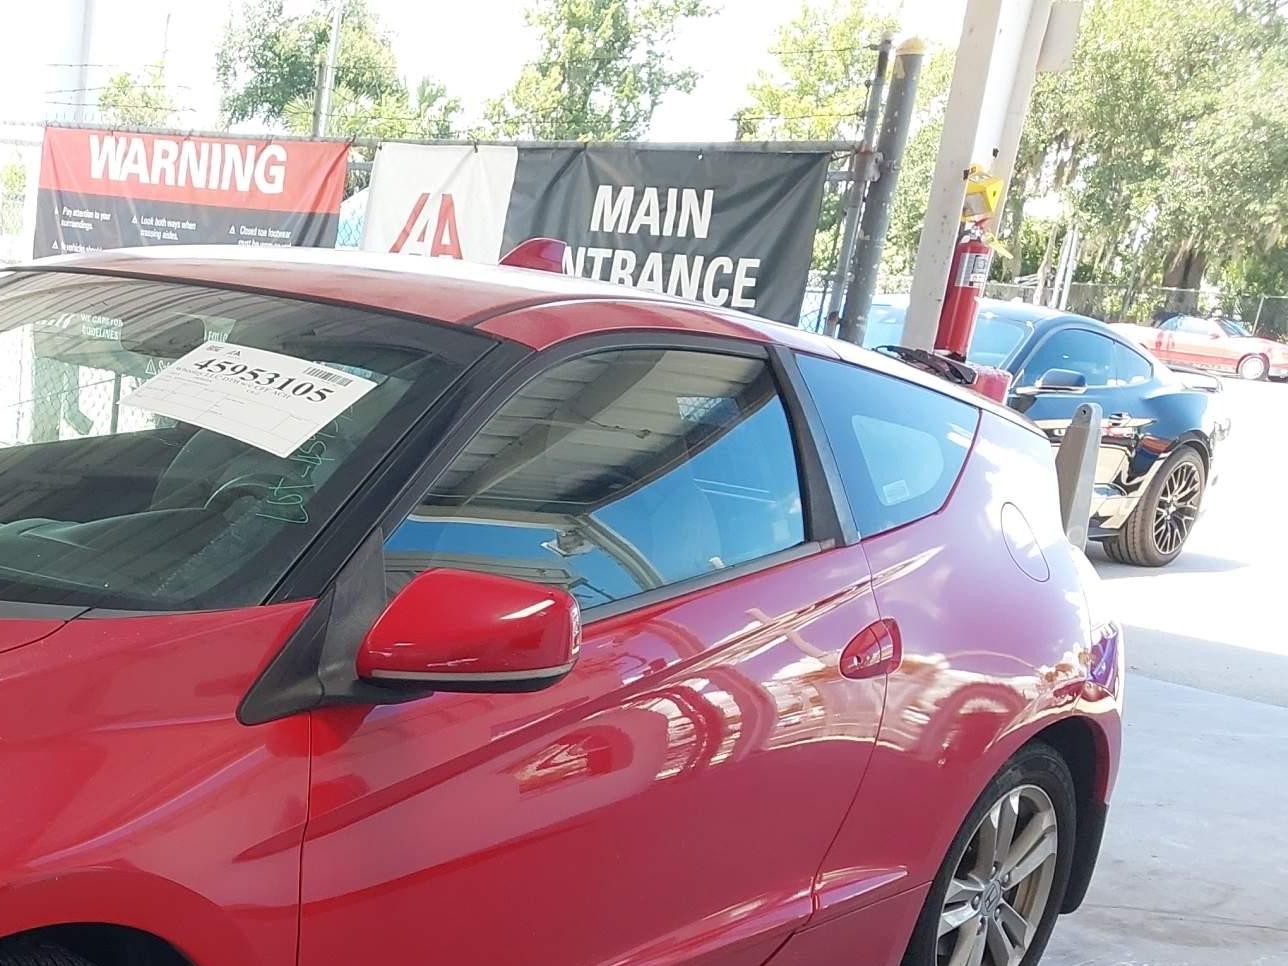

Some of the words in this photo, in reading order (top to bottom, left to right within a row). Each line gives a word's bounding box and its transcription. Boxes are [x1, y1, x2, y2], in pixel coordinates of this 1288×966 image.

[89, 134, 288, 194] WARNING
[141, 215, 154, 226] Look
[154, 215, 167, 227] both
[167, 219, 181, 230] ways
[181, 219, 196, 230] when
[239, 225, 257, 236] Closed
[267, 227, 291, 239] footwear
[590, 184, 714, 239] MAIN
[561, 245, 761, 308] NTRANCE
[194, 358, 335, 402] 45953105
